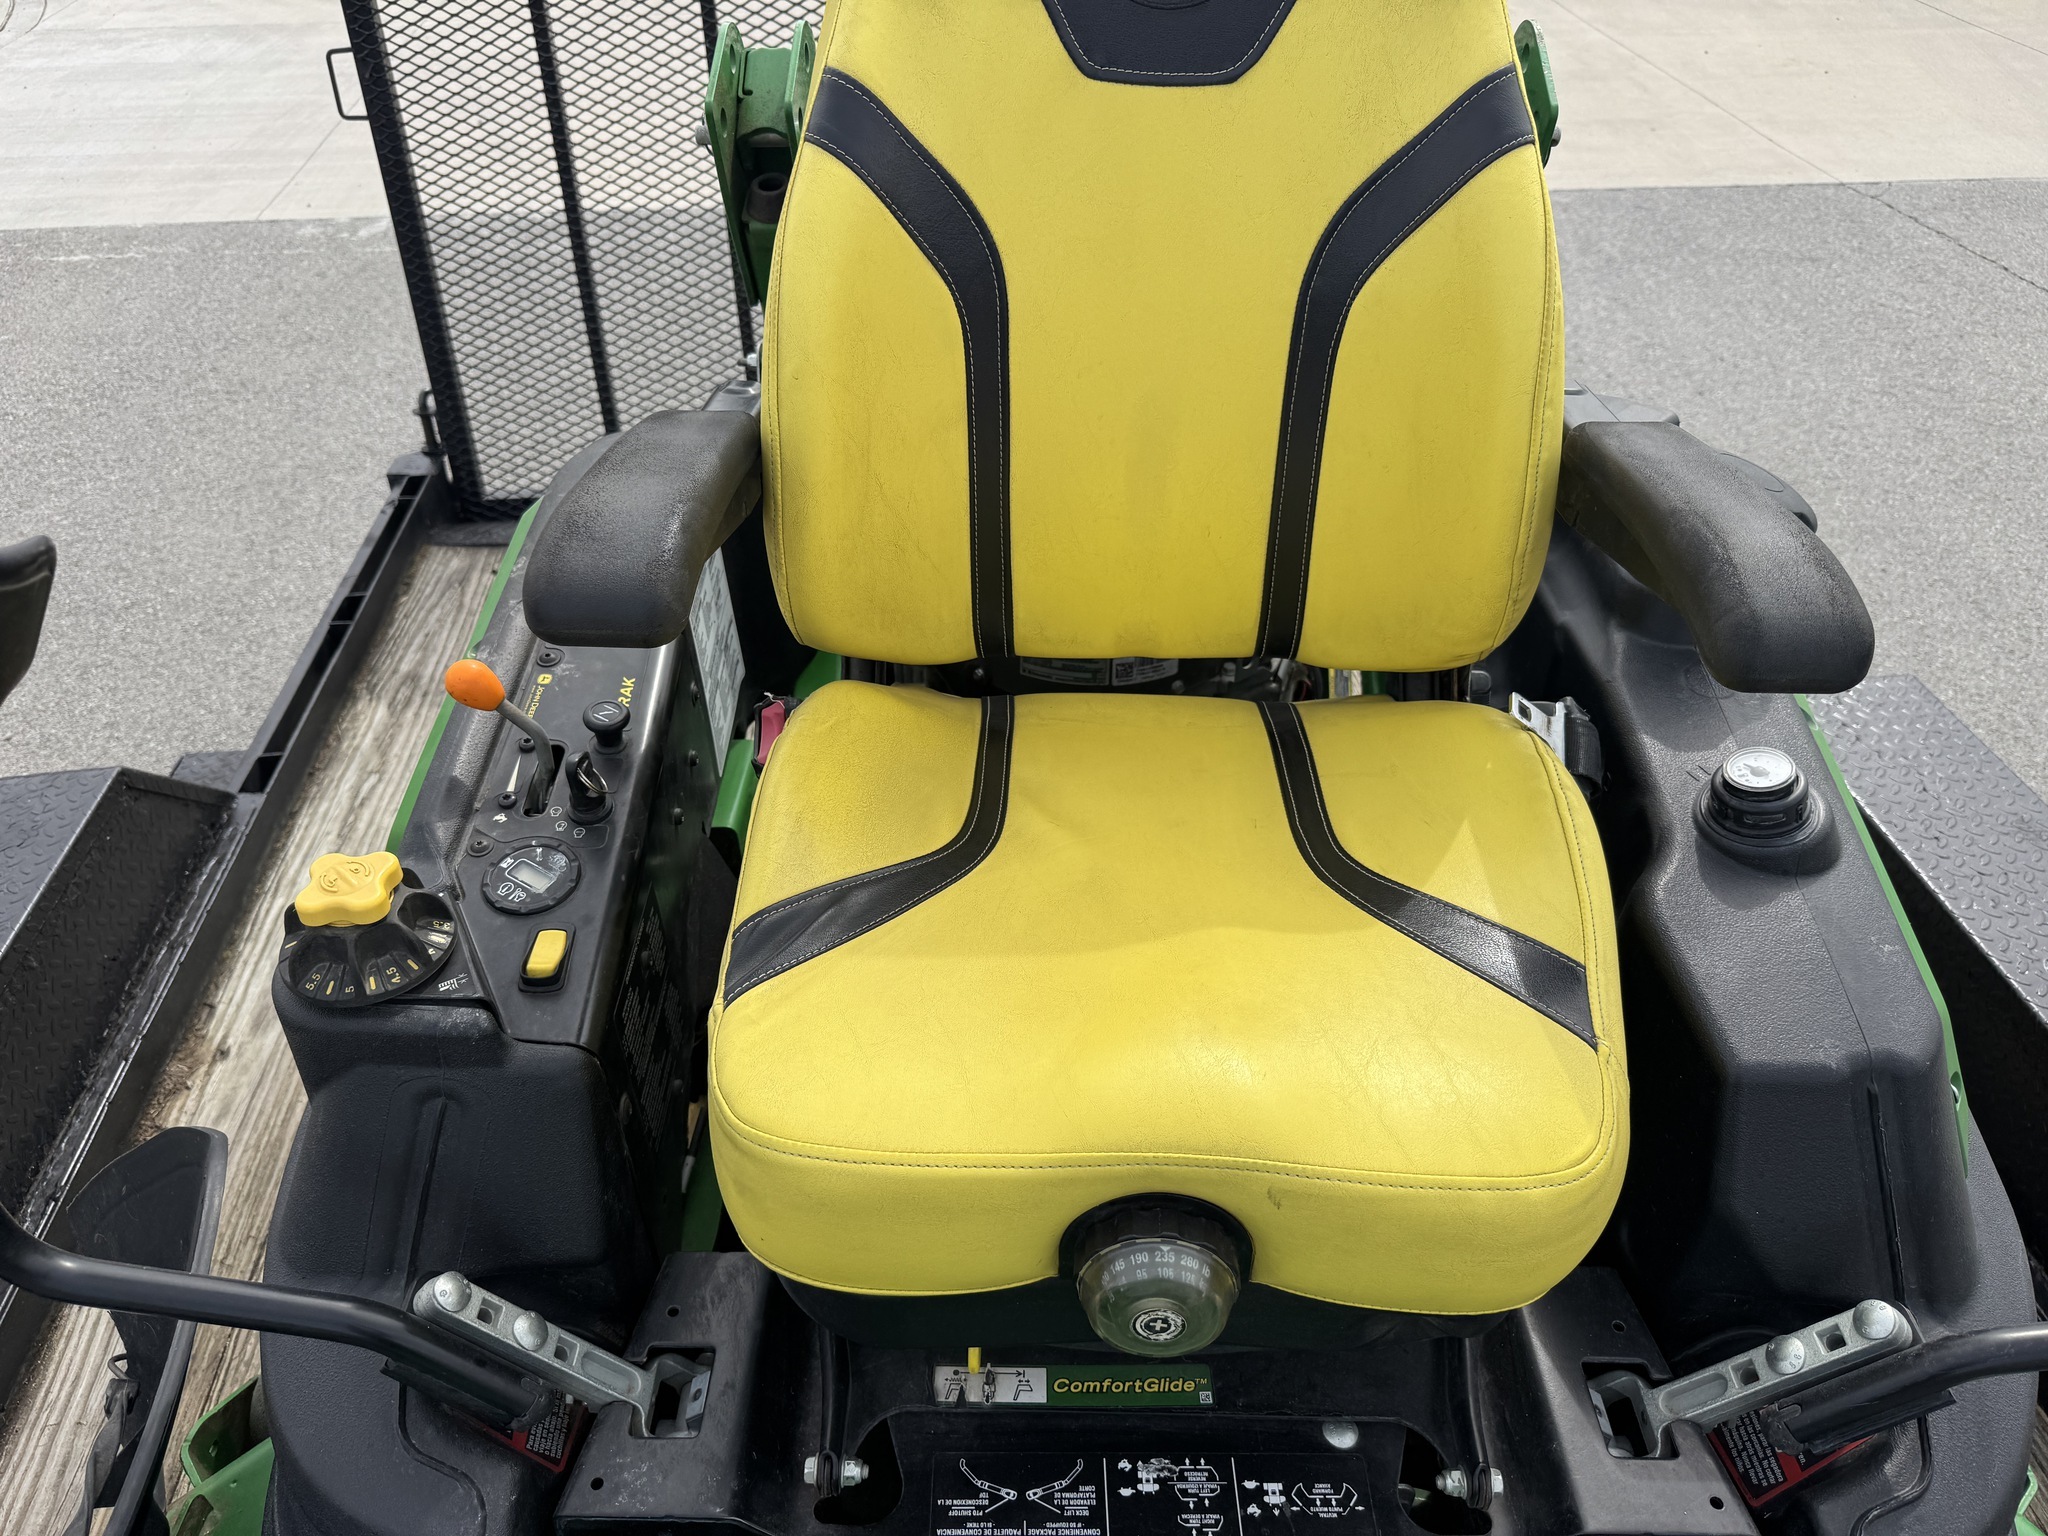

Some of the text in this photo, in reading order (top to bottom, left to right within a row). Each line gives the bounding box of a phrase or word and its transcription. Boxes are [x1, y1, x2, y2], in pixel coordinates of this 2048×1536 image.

[306, 973, 320, 991] 5.5
[1110, 1259, 1125, 1275] 145
[1130, 1252, 1149, 1265] 190
[1155, 1251, 1175, 1263] 235
[1180, 1254, 1199, 1270] 280
[1202, 1264, 1211, 1278] lb
[526, 1436, 534, 1449] Para
